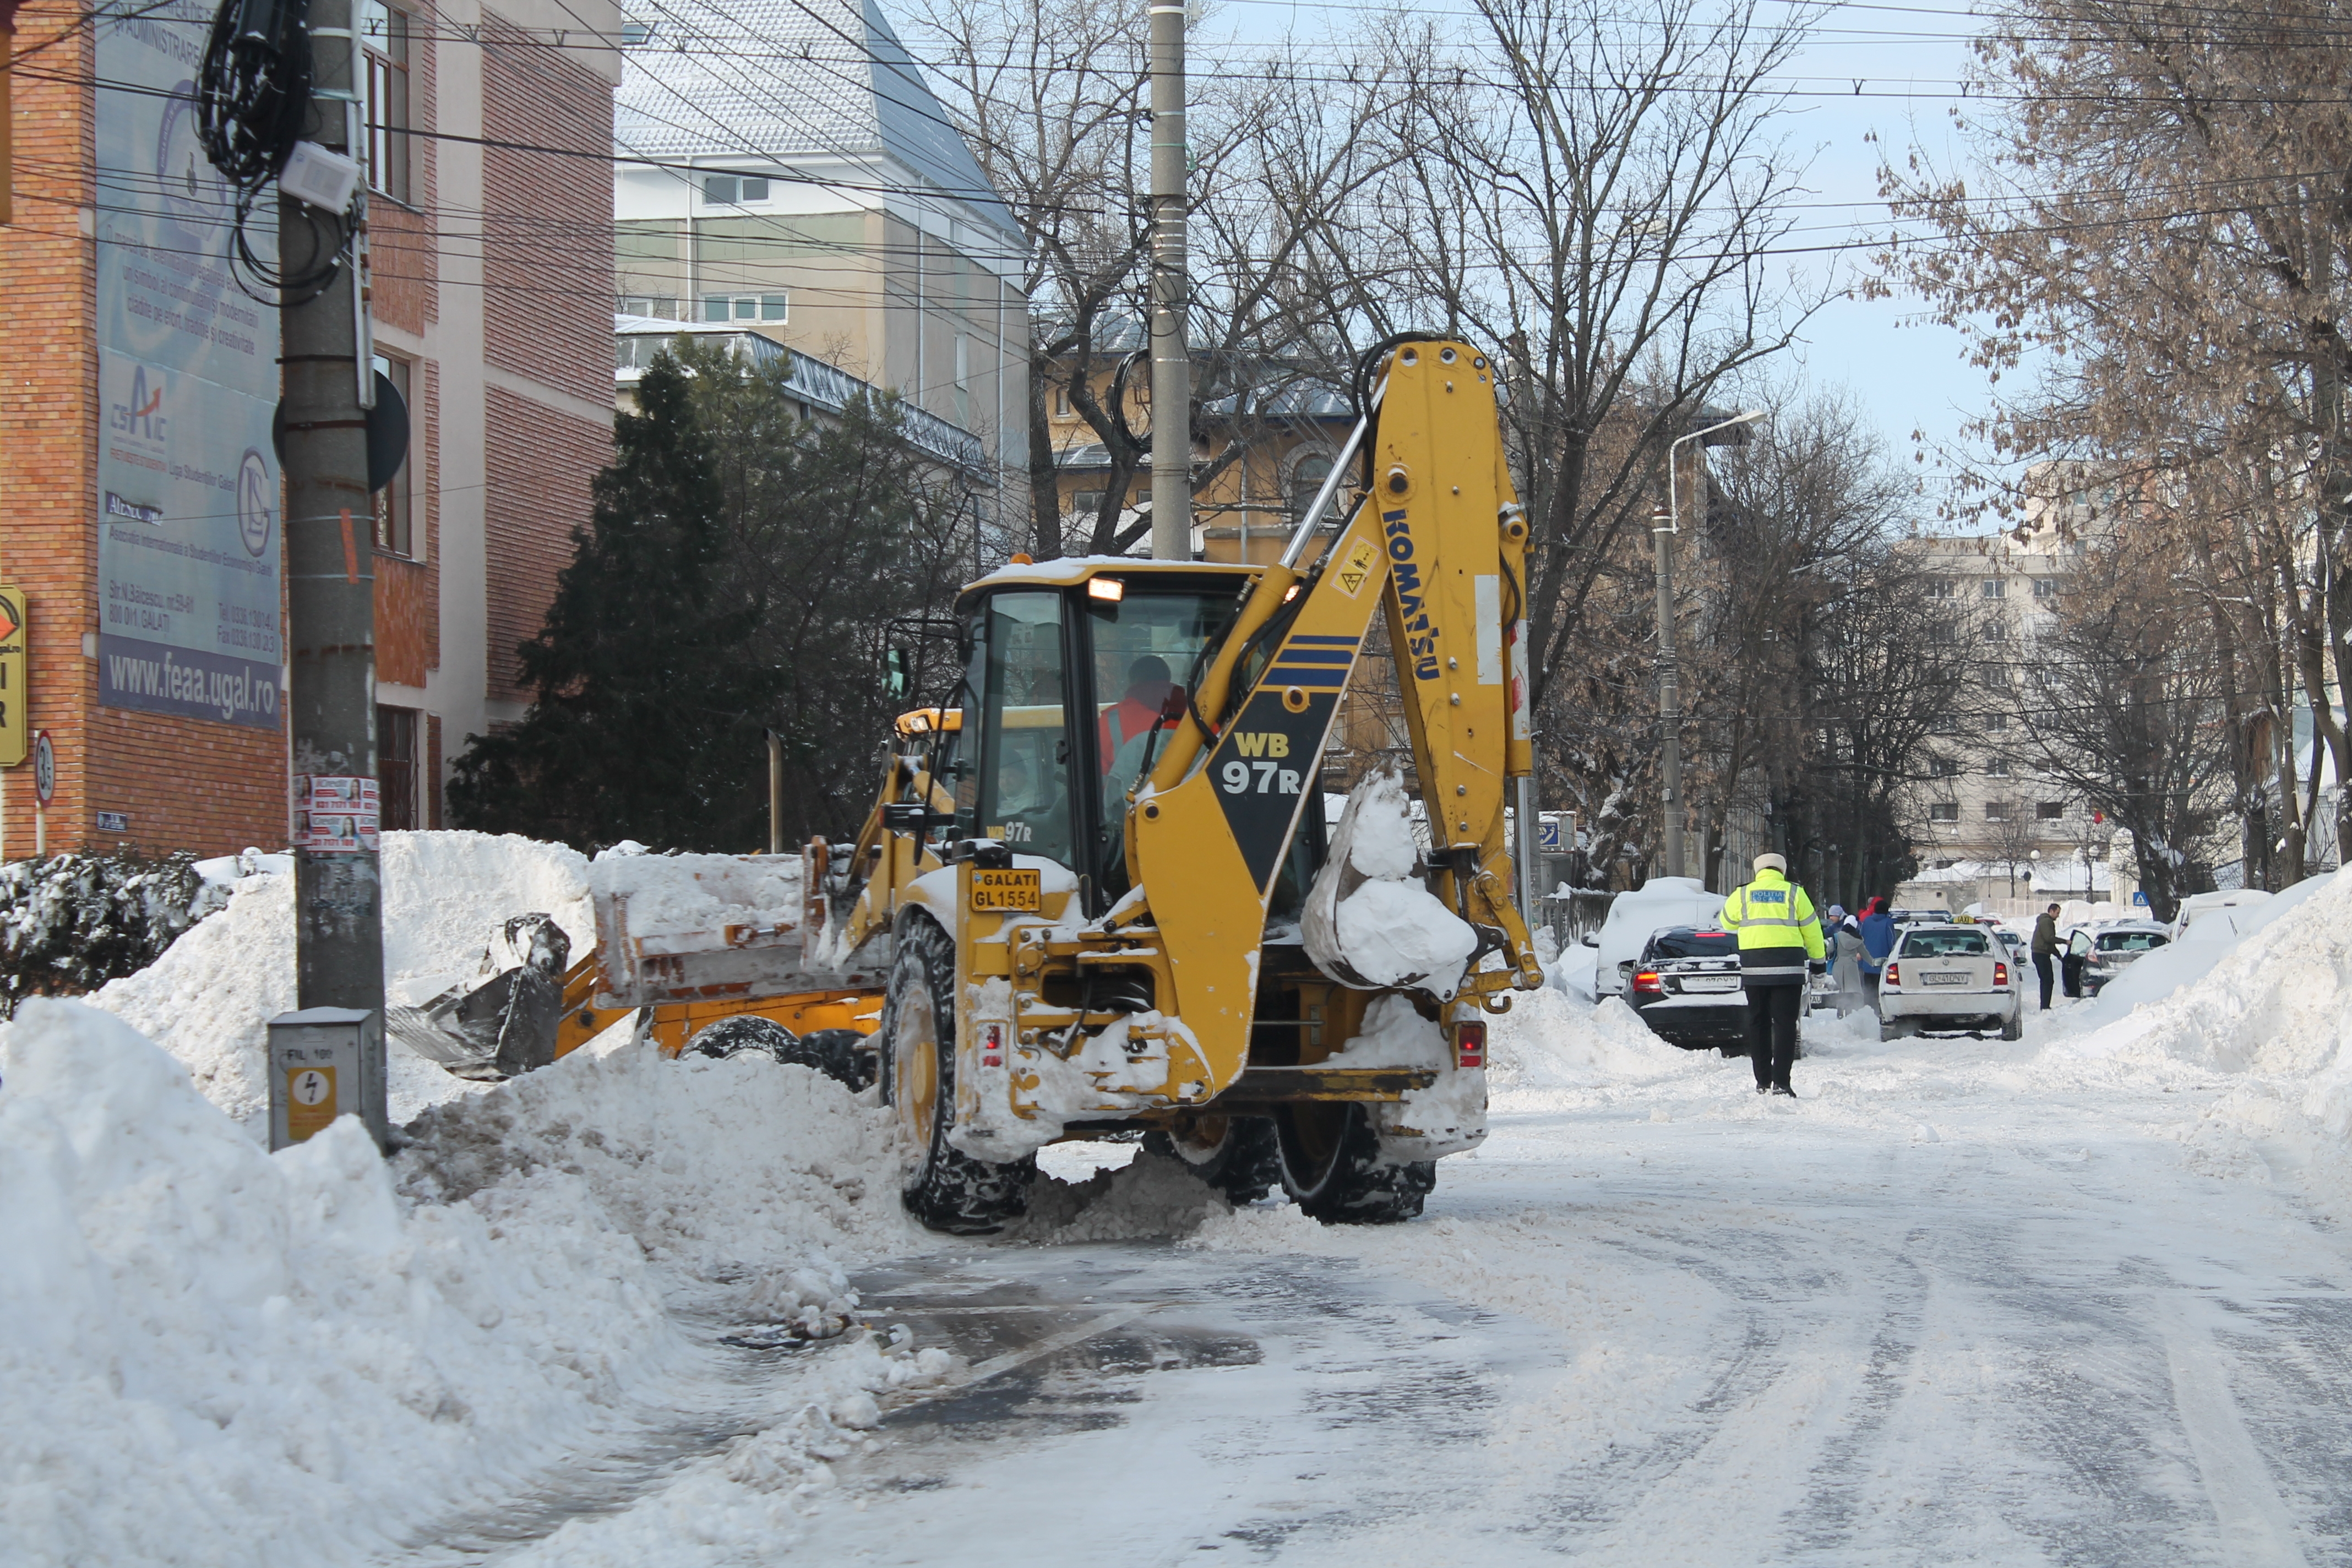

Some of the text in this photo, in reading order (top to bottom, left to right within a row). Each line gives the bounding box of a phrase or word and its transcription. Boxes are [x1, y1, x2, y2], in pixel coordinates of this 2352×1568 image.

[123, 265, 132, 281] un
[135, 266, 157, 291] simbol
[154, 306, 162, 325] pe
[1382, 509, 1441, 680] KOMATSU
[108, 651, 275, 720] www.feaa.ugal.ro
[1233, 732, 1289, 758] WB
[1222, 761, 1302, 794] 97R
[984, 874, 1037, 886] GALATI
[998, 891, 1036, 906] 1554
